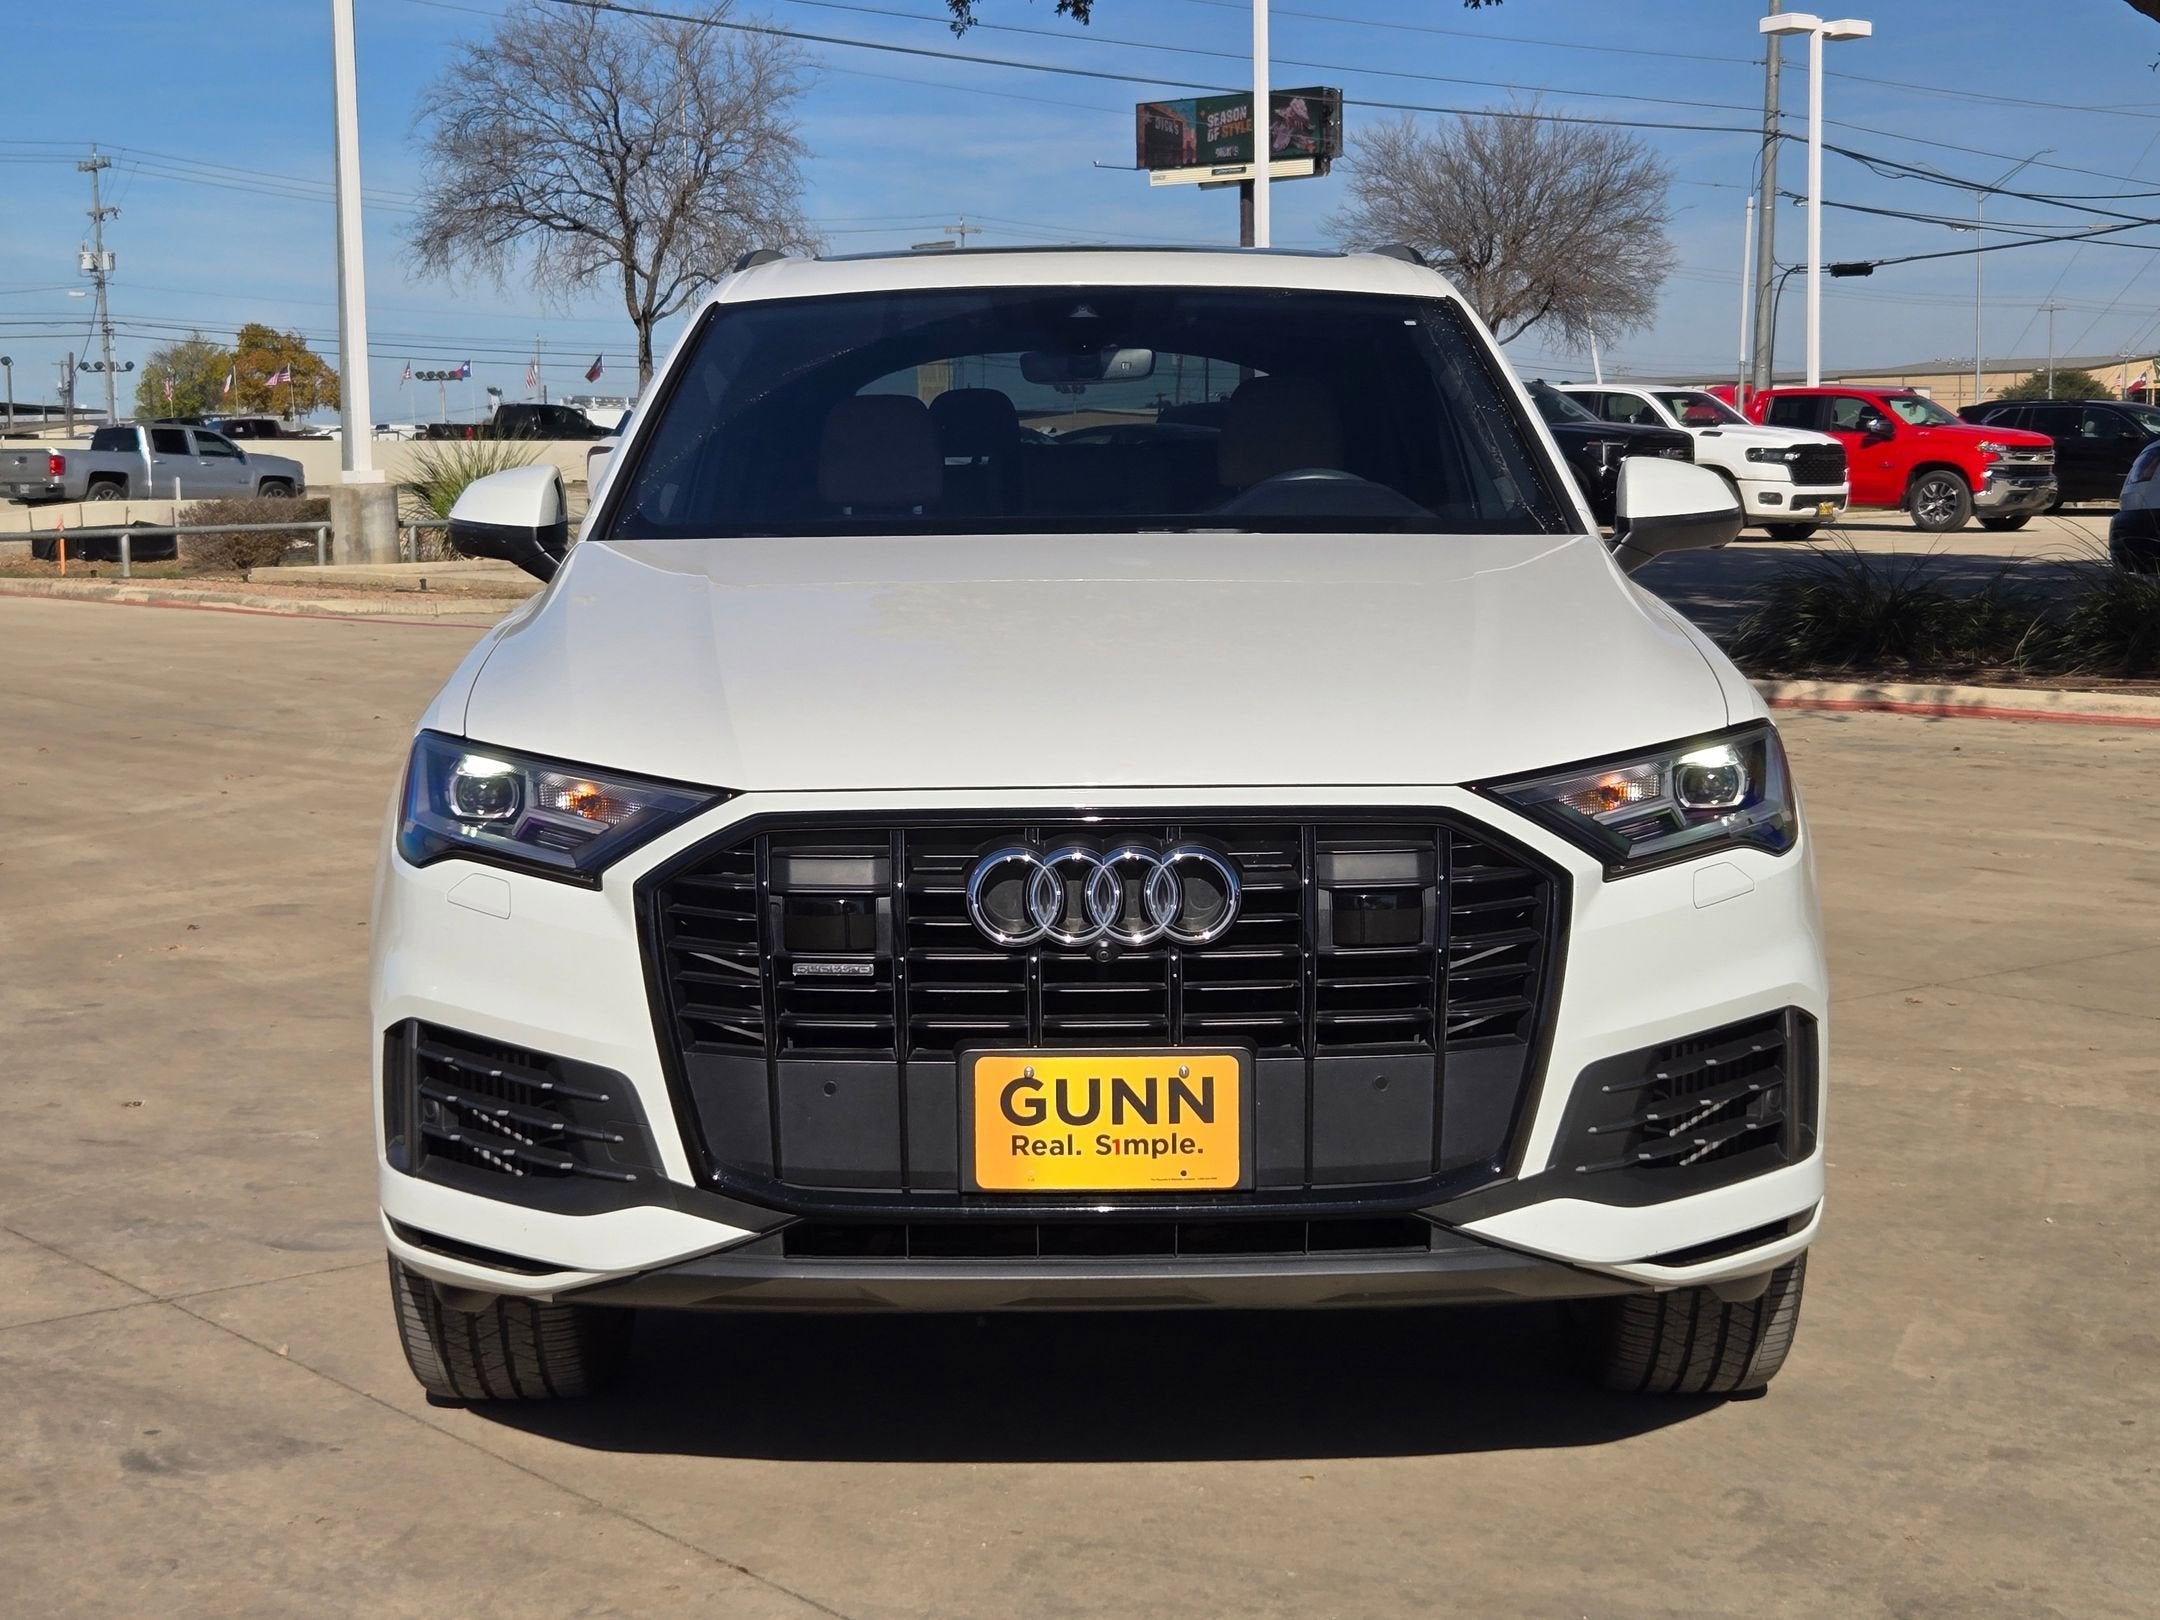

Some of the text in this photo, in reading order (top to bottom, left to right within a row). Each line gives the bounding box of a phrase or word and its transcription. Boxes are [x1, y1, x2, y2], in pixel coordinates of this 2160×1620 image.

[1207, 105, 1247, 128] SEASON
[1207, 118, 1253, 142] OF STYLE
[1000, 1076, 1214, 1126] GUNN
[1011, 1134, 1082, 1156] Real.
